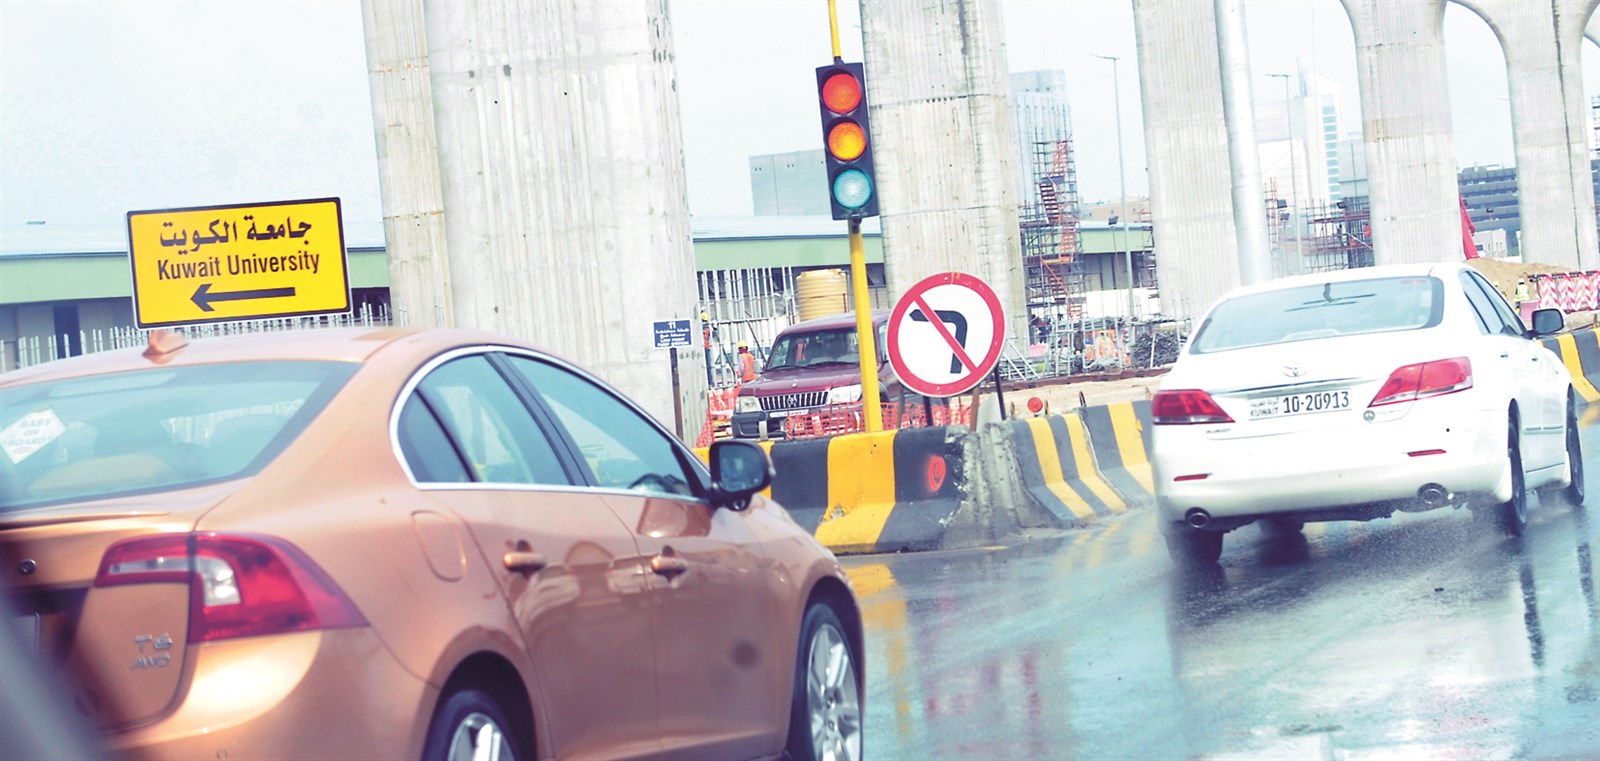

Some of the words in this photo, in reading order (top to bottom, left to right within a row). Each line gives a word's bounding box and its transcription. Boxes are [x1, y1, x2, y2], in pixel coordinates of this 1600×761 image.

[160, 218, 239, 255] الكويت
[244, 214, 313, 246] جامعة
[157, 256, 222, 280] Kuwait
[228, 250, 320, 276] University
[134, 632, 173, 652] T6
[131, 653, 171, 671] AWD
